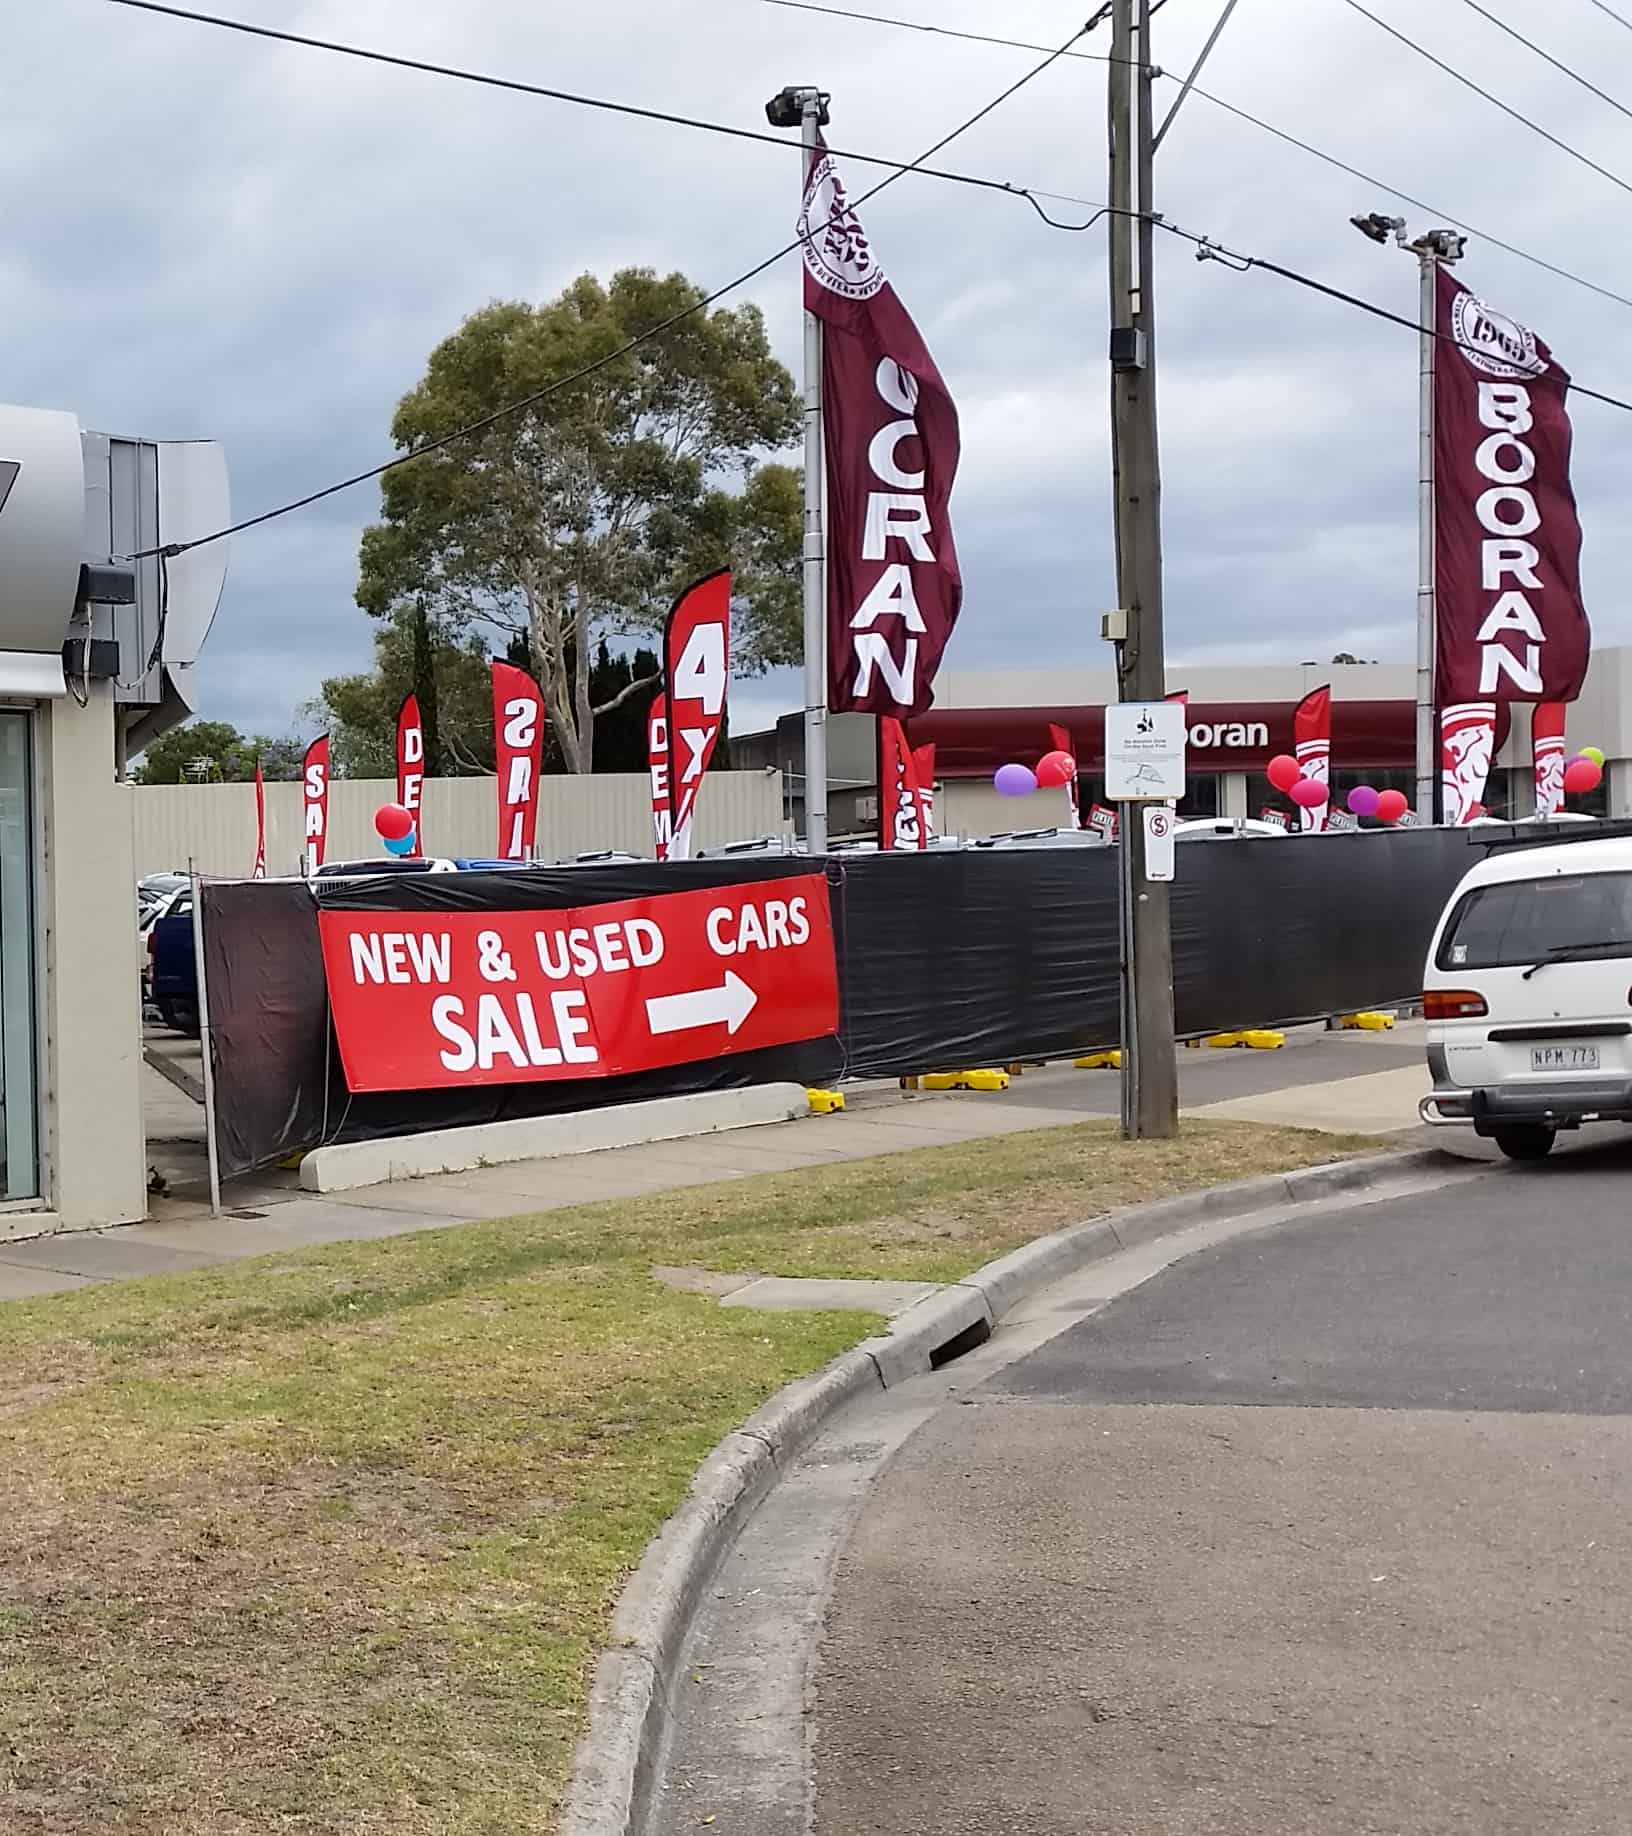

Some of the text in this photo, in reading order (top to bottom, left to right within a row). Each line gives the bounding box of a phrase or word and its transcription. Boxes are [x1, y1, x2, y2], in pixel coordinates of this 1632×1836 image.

[1475, 381, 1545, 695] BOORAN
[1184, 722, 1269, 748] oran
[349, 896, 810, 985] NEW & USED CARS
[431, 990, 599, 1072] SALE
[1534, 1051, 1563, 1065] NPM
